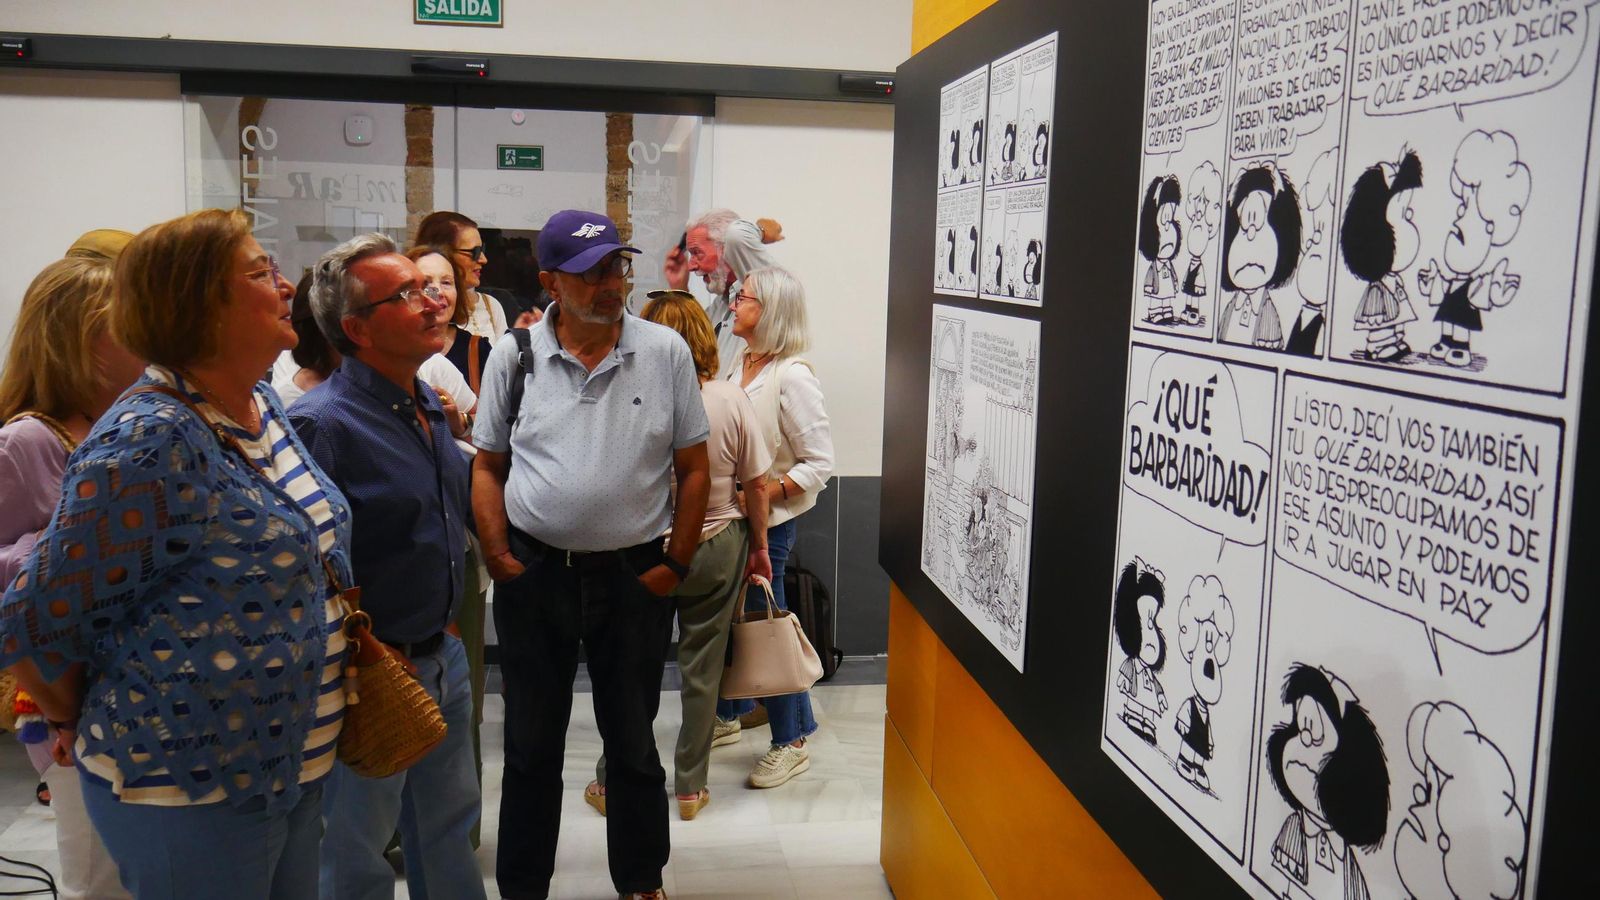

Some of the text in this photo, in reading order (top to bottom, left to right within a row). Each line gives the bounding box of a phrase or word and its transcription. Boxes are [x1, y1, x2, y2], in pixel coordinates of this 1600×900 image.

[424, 0, 493, 17] SALIDA
[1153, 9, 1167, 28] HOY
[1168, 6, 1176, 21] EN
[1151, 24, 1231, 70] EN TODO EL MUNDO
[1152, 31, 1165, 49] UNA
[1166, 19, 1192, 42] NOTICIA
[1240, 10, 1348, 59] NACIONAL DEL TRABAJO
[1357, 8, 1577, 83] ES INDIGNARNOS Y DECIR
[1359, 32, 1376, 54] LO
[1377, 22, 1417, 51] ÚNICO
[1421, 11, 1450, 39] QUE
[1150, 64, 1189, 89] TRABAJAN
[1189, 57, 1202, 76] 43
[1236, 63, 1341, 108] MILLONES DE CHICOS
[1238, 69, 1246, 84] Y
[1247, 57, 1265, 82] QUÉ
[1266, 52, 1278, 77] SÉ
[1149, 71, 1224, 109] NES DE CHICOS EN
[1374, 74, 1412, 109] QUÉ
[1147, 101, 1198, 128] CONDICIONES
[1234, 94, 1326, 132] DEBEN TRABAJAR
[1148, 126, 1182, 146] CIENTES
[1234, 136, 1256, 154] PARA
[1153, 374, 1218, 436] ¡QUÉ
[1352, 404, 1394, 443] DECÍ
[1397, 416, 1434, 452] VOS
[1440, 424, 1539, 477] TAMBIÉN
[1129, 425, 1268, 524] BARBARIDAD!
[1286, 427, 1544, 520] TU QUÉ BARBARIDAD, ASÍ
[1283, 459, 1540, 563] NOS DESPREOCUPAMOS DE
[1283, 492, 1530, 603] ESE ASUNTO Y PODEMOS
[1283, 521, 1493, 628] IR A JUGAR EN PAZ
